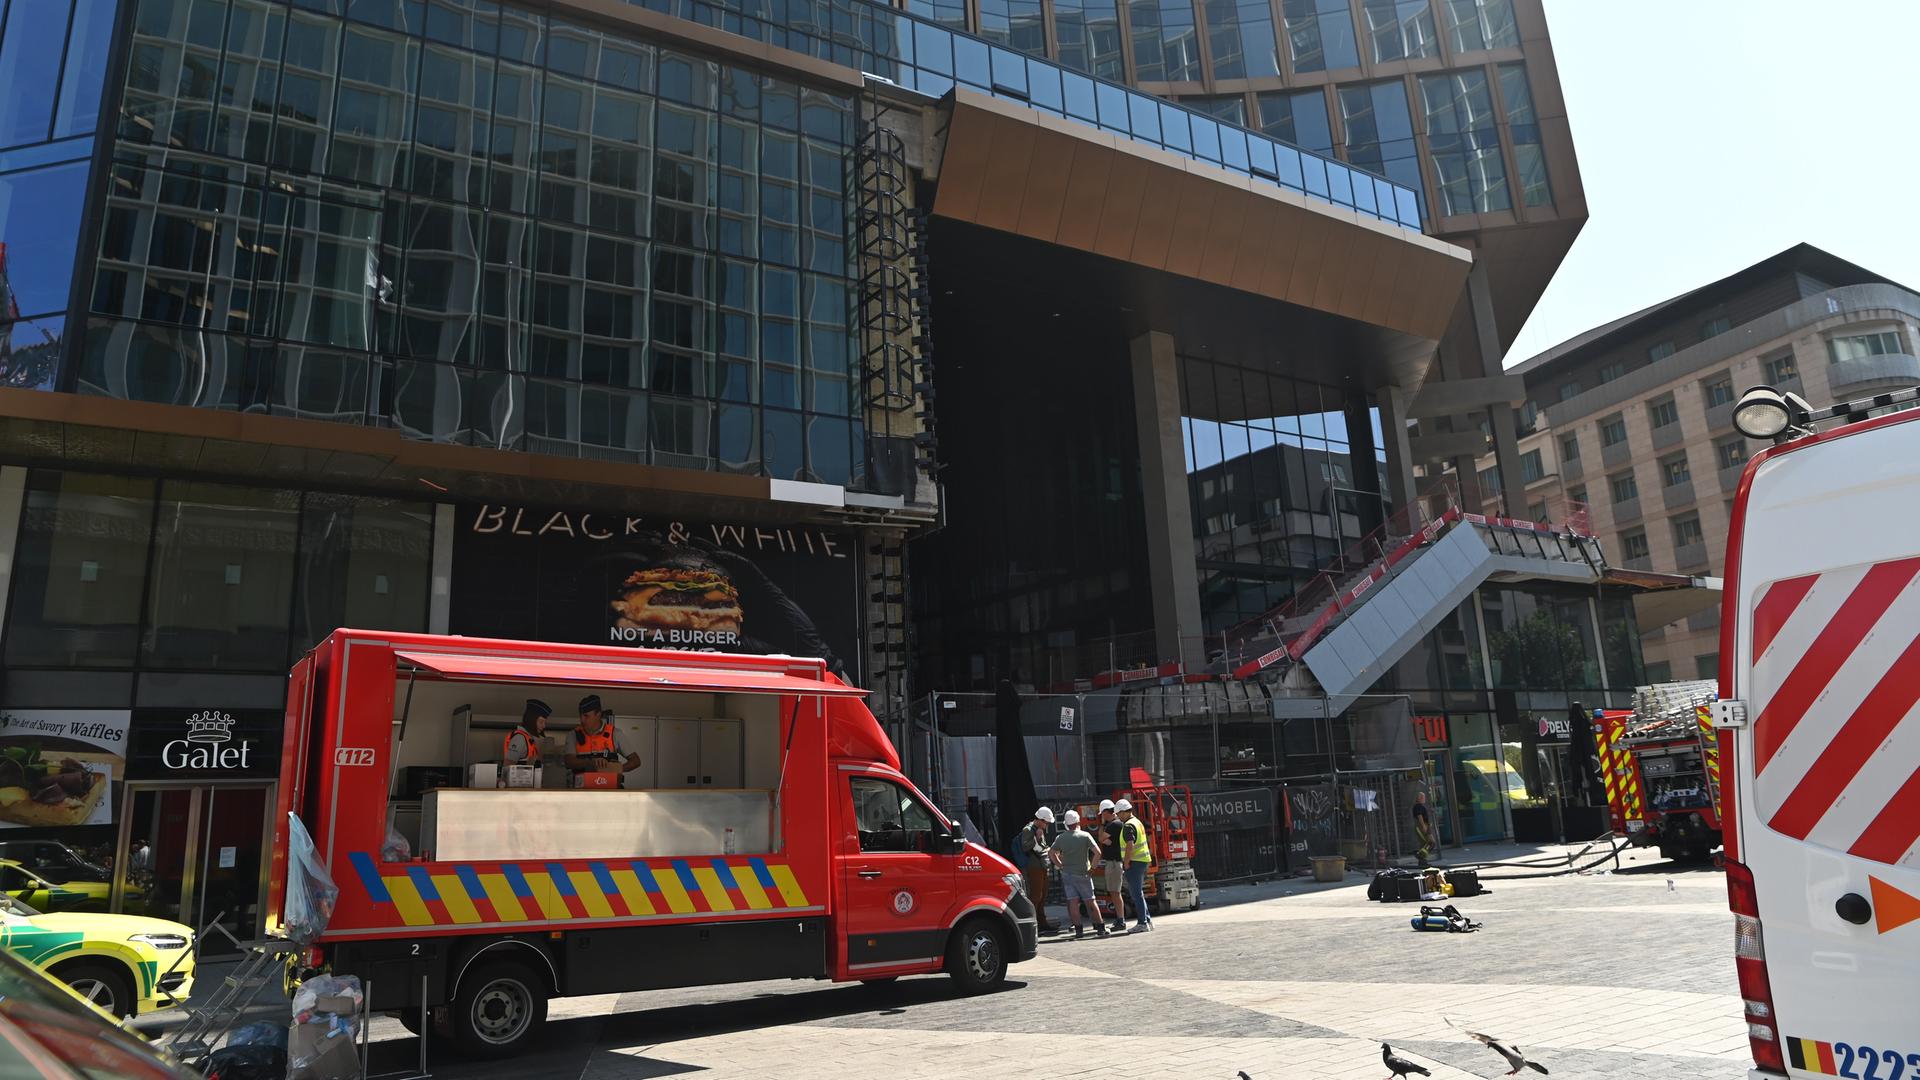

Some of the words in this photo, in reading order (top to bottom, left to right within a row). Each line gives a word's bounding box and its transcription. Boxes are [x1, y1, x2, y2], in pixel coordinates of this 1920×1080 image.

[473, 505, 642, 540] BLACK
[668, 521, 690, 546] &
[711, 524, 847, 558] WHITE
[610, 626, 648, 641] NOT
[652, 628, 665, 642] A
[670, 629, 741, 646] BURGER,
[1122, 668, 1156, 680] COMBISAFE
[20, 719, 29, 728] Art
[29, 720, 38, 730] of
[37, 720, 67, 736] Savory
[70, 722, 124, 741] Waffles
[1549, 720, 1574, 734] DELY
[162, 740, 251, 769] Galet
[345, 750, 374, 765] 112
[1194, 800, 1263, 817] IMMOBEL
[965, 856, 980, 865] C12
[797, 923, 804, 933] 1
[411, 944, 420, 955] 2
